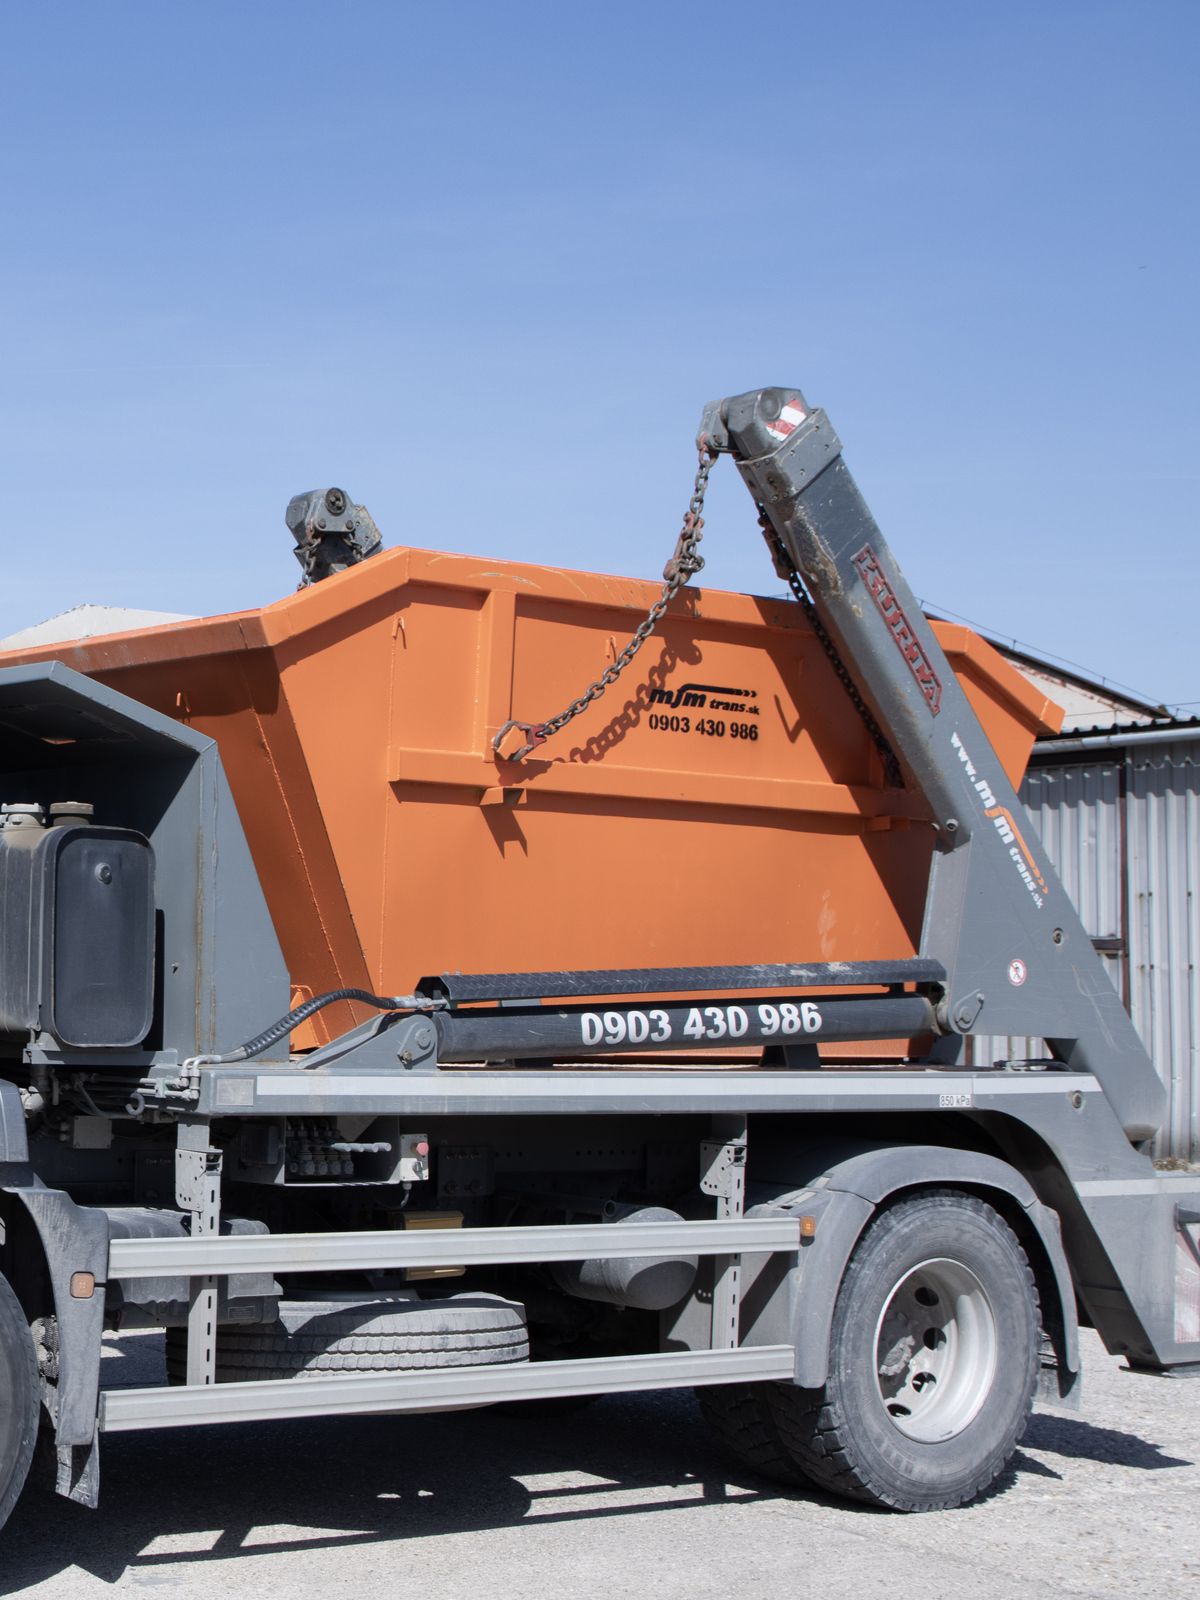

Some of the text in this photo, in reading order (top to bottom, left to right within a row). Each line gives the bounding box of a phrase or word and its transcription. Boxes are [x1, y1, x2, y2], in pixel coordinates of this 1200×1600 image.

[709, 698, 760, 716] trans.sk
[649, 713, 760, 742] 0903 430 986
[1009, 846, 1044, 910] trans.sk
[580, 1002, 823, 1046] 0903 430 986
[941, 1094, 971, 1107] 850 kPa
